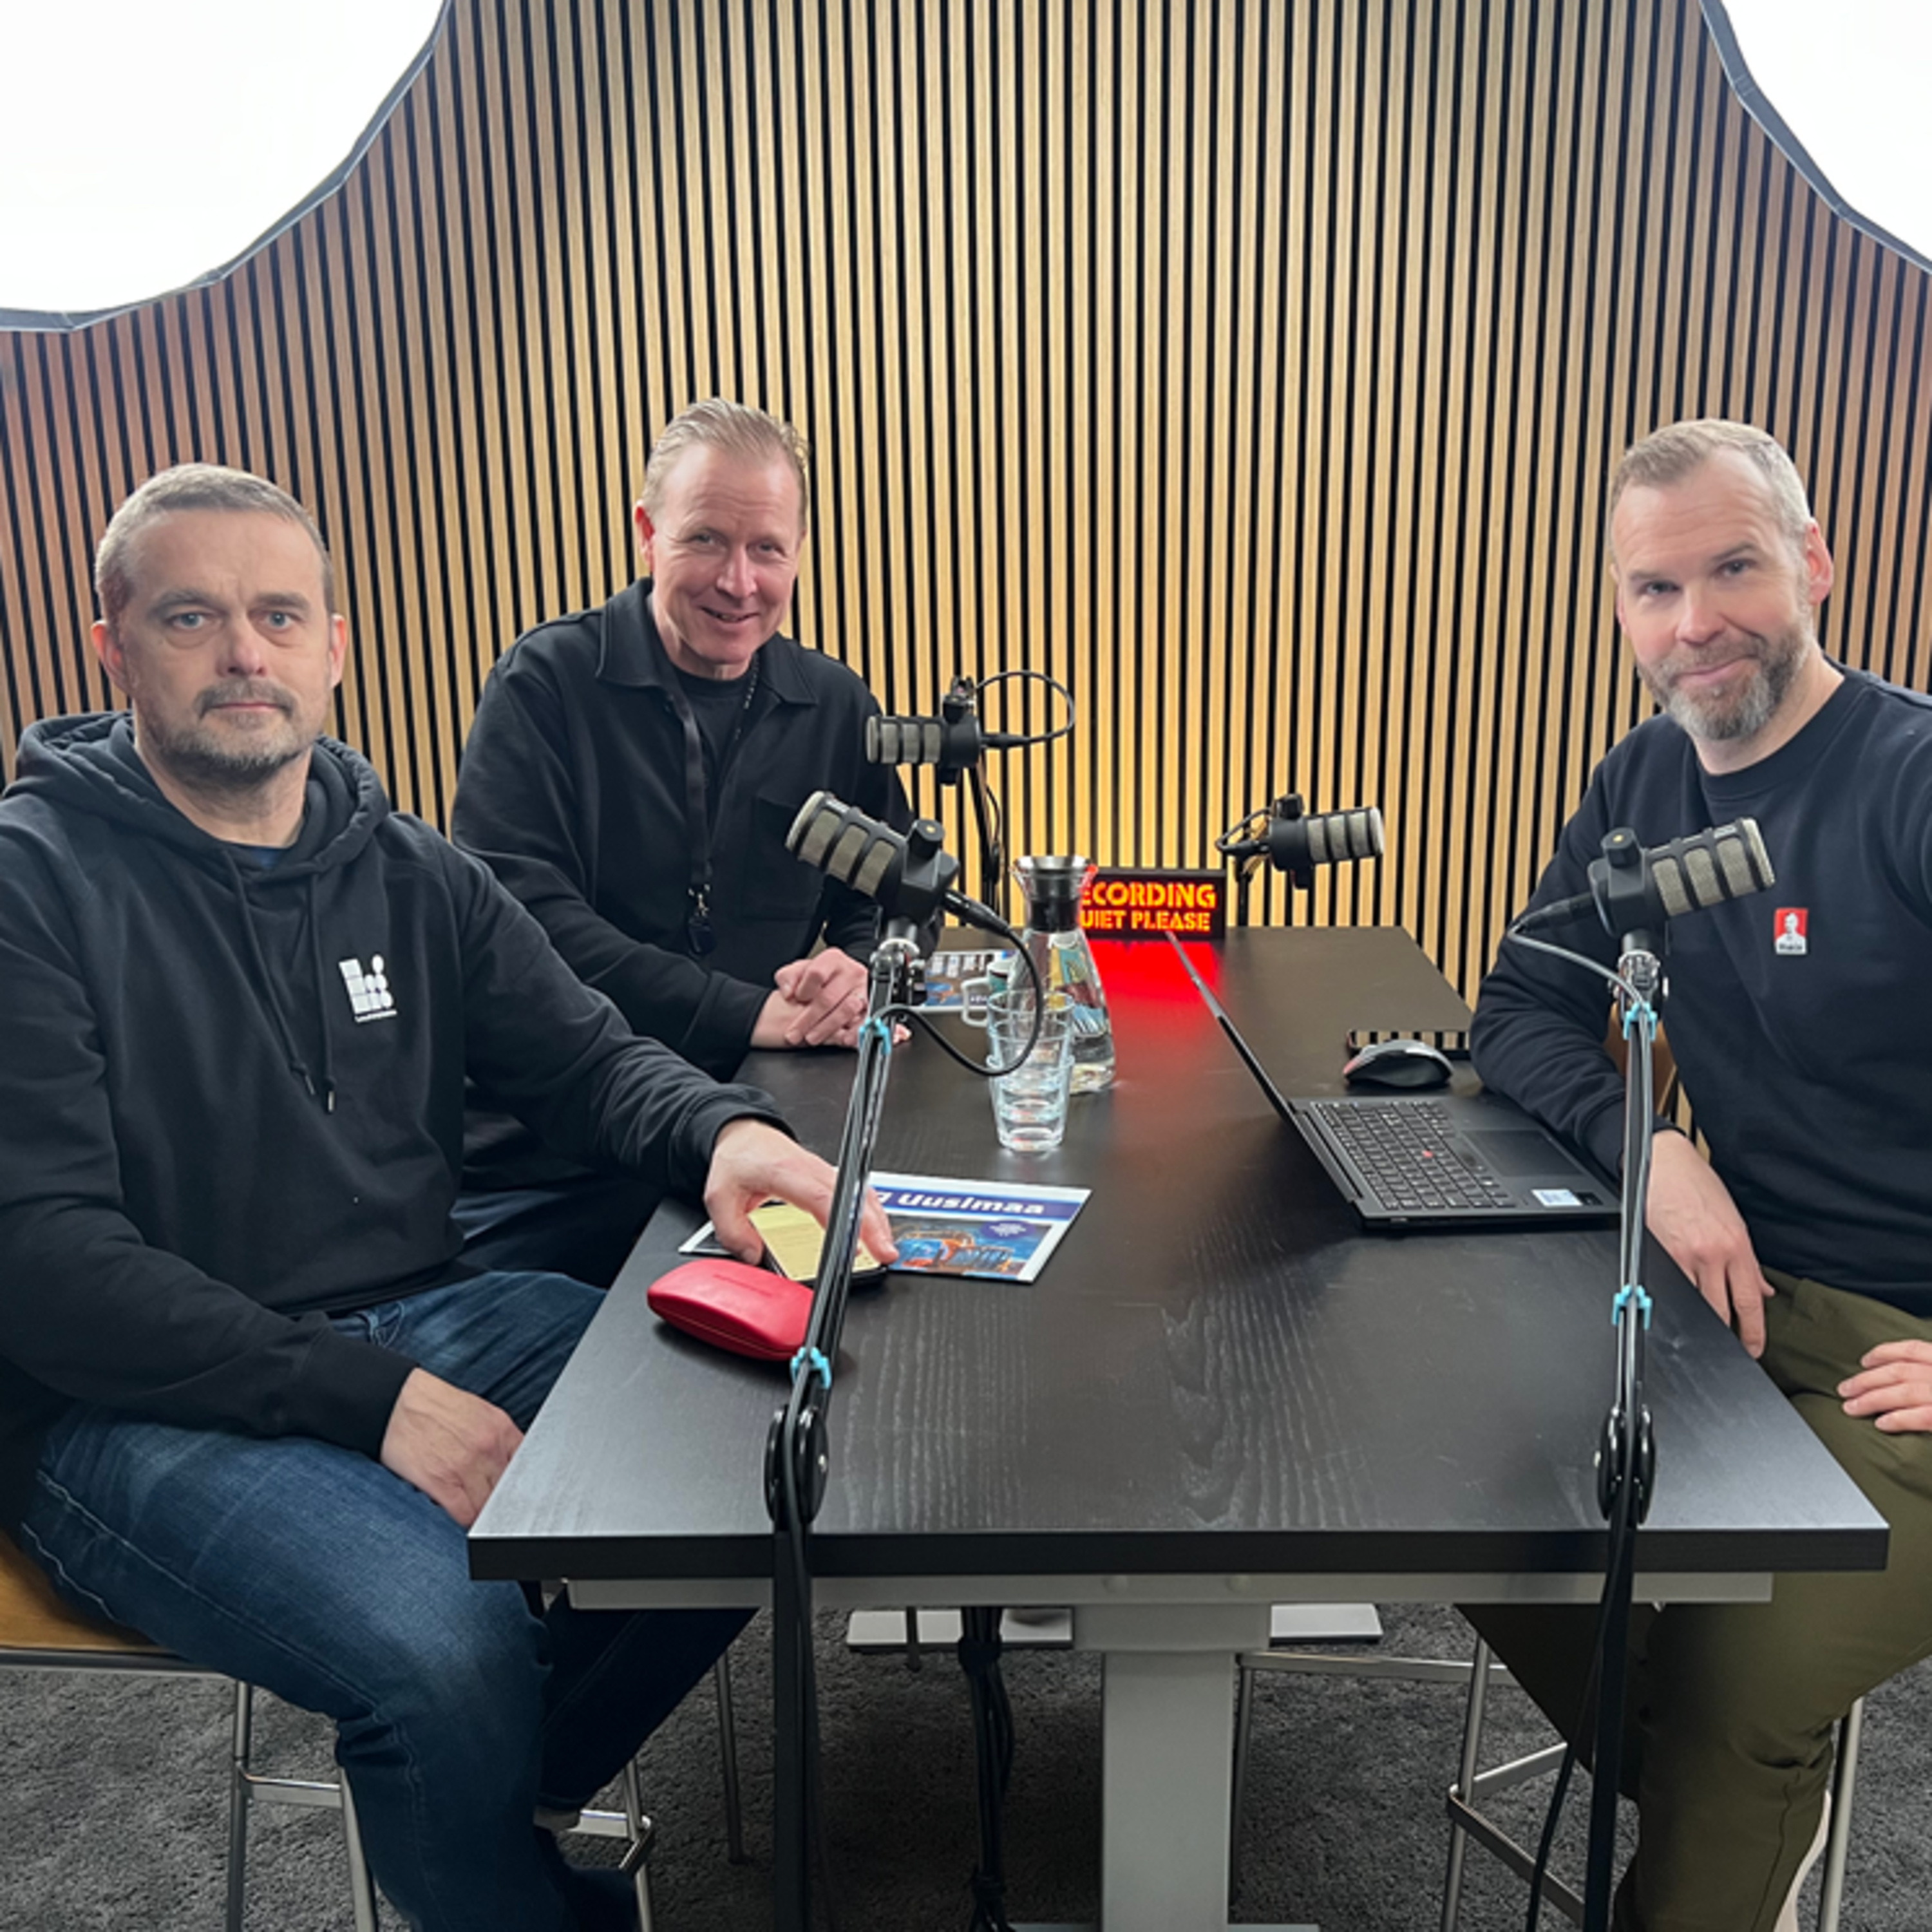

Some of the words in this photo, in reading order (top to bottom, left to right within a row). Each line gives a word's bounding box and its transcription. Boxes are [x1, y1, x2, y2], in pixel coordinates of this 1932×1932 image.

[1079, 882, 1216, 907] ECORDING
[1079, 909, 1126, 929] UIET
[1131, 911, 1211, 931] PLEASE
